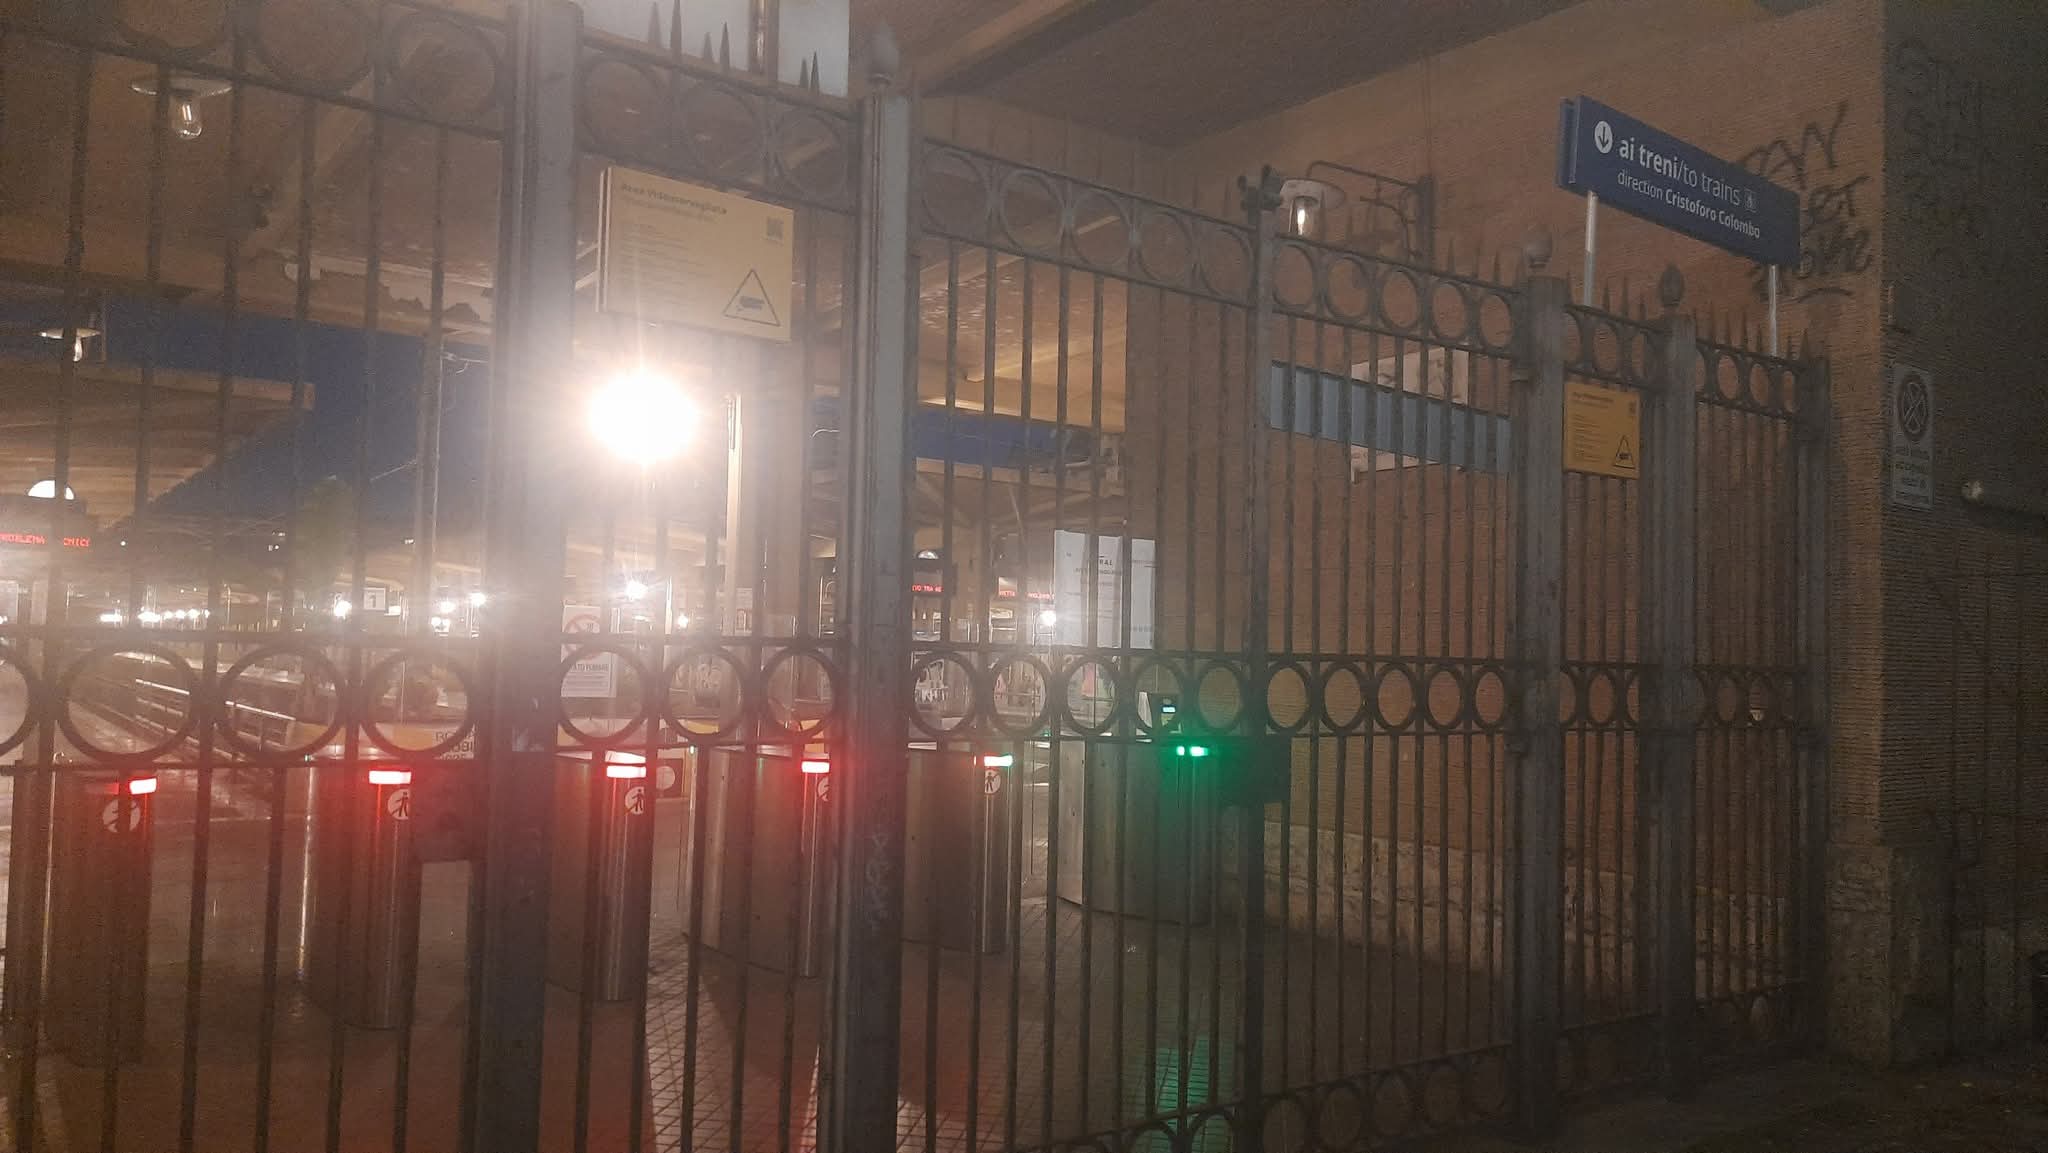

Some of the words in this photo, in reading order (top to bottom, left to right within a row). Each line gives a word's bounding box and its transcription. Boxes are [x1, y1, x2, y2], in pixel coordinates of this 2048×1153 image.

[1617, 168, 1664, 201] direction
[1665, 188, 1717, 222] Cristoforo
[1718, 210, 1760, 240] Colombo
[1618, 137, 1635, 162] ai
[1639, 144, 1698, 188] treni/to
[1701, 171, 1742, 207] trains
